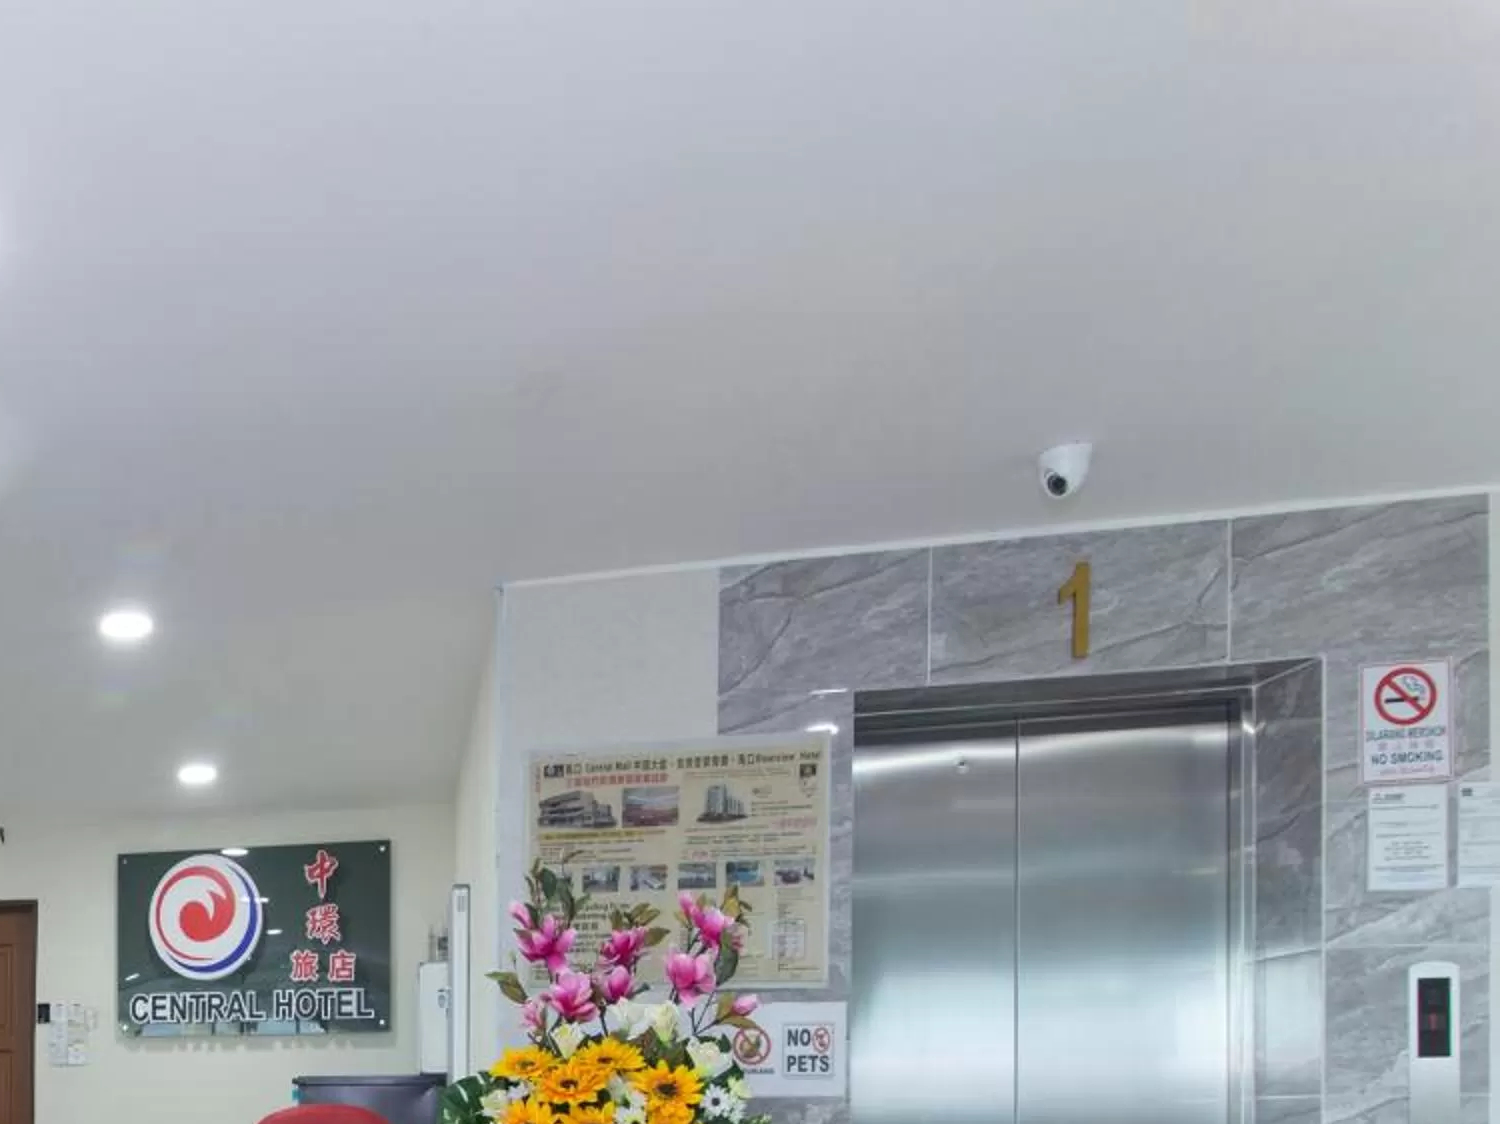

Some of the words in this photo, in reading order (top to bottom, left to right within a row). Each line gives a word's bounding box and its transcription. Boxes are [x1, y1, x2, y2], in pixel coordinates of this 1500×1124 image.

[1058, 561, 1090, 659] 1
[1371, 753, 1388, 766] NO
[1390, 749, 1444, 764] SMOKING
[290, 950, 356, 981] 旅店
[130, 990, 266, 1025] CENTRAL
[273, 987, 375, 1022] HOTEL
[786, 1028, 811, 1047] NO
[786, 1055, 830, 1073] PETS
